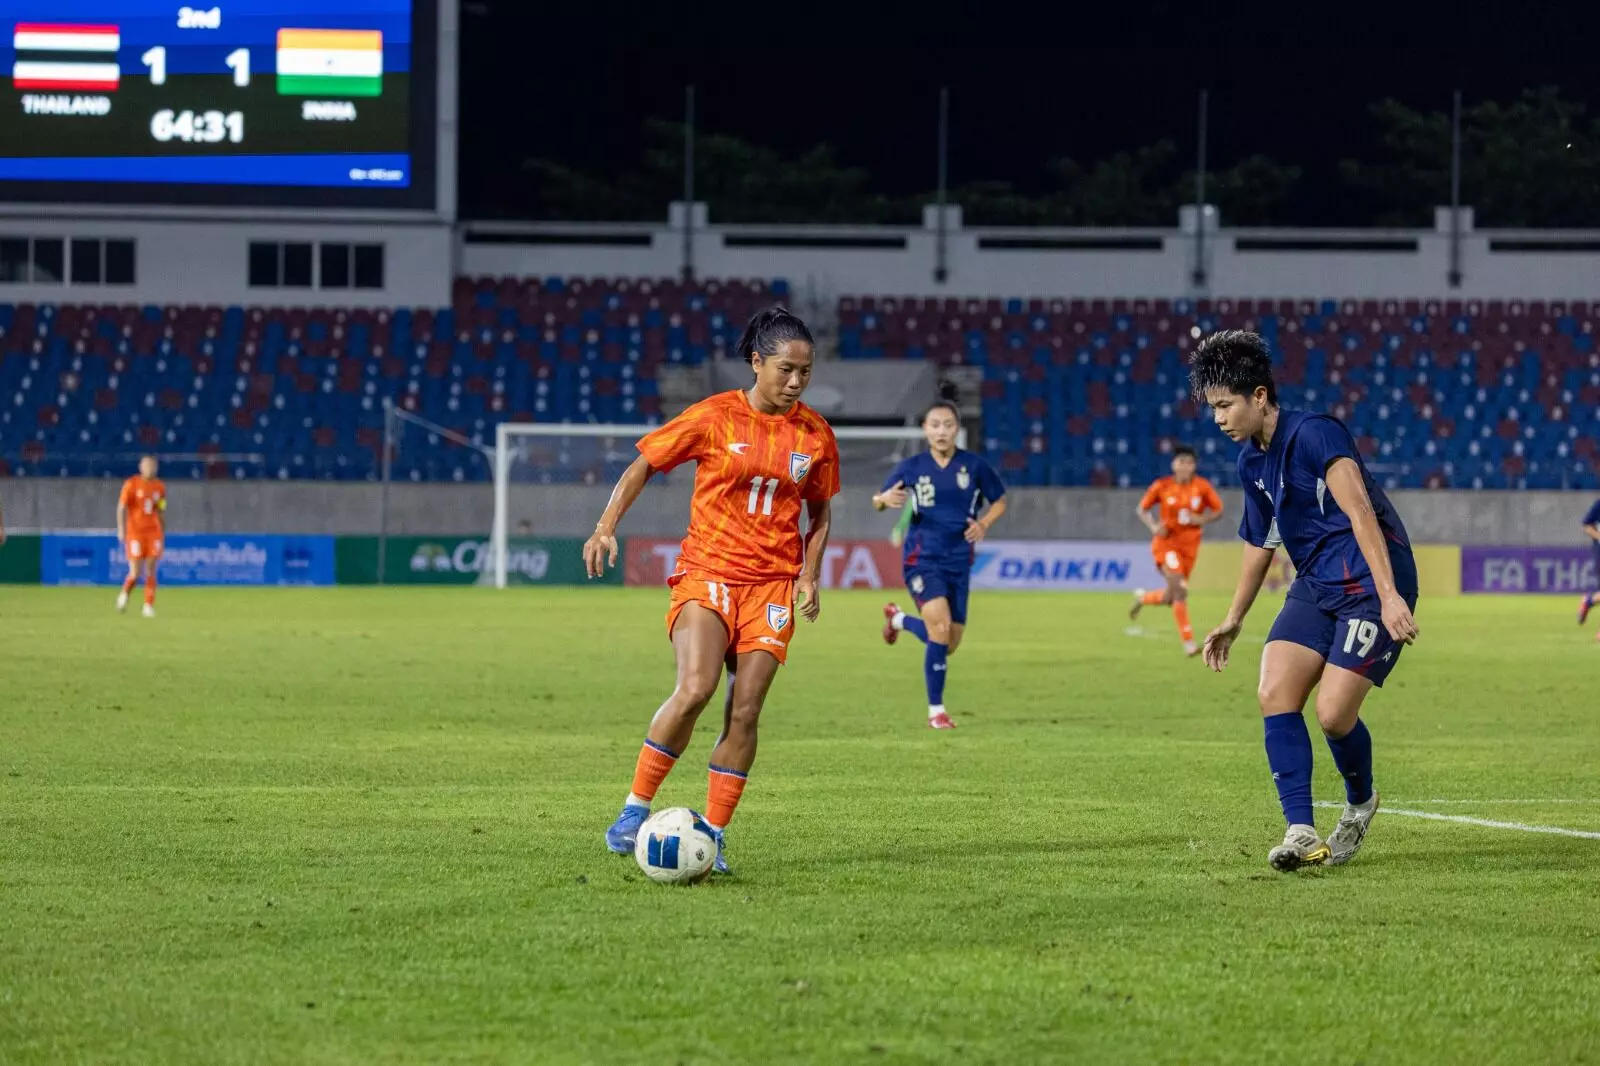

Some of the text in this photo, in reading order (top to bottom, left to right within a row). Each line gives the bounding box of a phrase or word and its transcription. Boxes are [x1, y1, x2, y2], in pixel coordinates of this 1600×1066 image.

[177, 7, 221, 29] 2nd
[141, 46, 250, 87] 1 1
[21, 94, 111, 115] THAILAND
[151, 109, 244, 143] 64:31
[748, 475, 780, 516] 11
[915, 483, 935, 507] 12
[998, 558, 1131, 582] DAIKIN
[1484, 558, 1525, 590] FA
[704, 580, 730, 616] 11
[1343, 618, 1379, 658] 19
